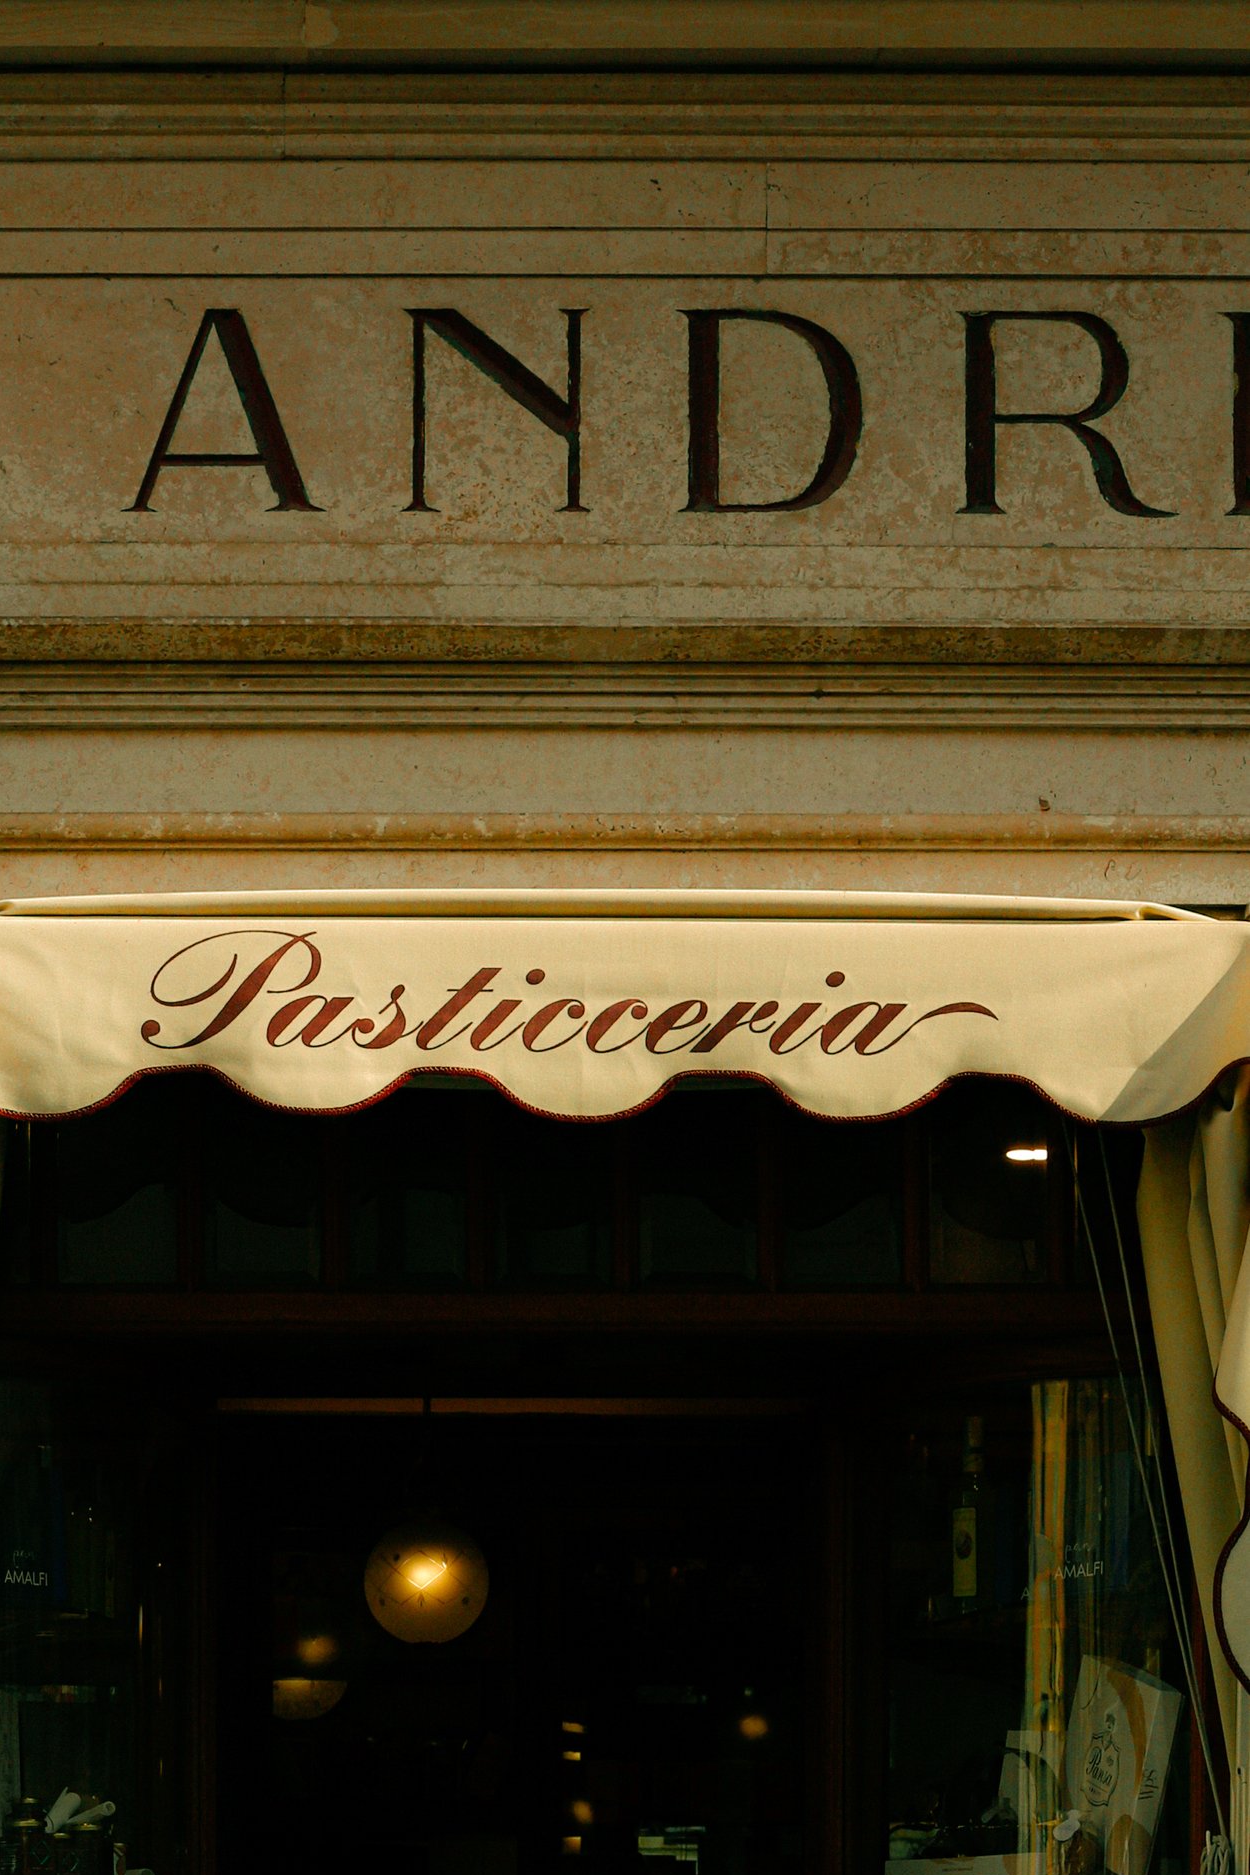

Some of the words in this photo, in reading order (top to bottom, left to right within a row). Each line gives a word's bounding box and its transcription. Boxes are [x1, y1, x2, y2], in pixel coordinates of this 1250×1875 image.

[120, 307, 1250, 518] ANDR
[139, 930, 998, 1056] Pasticceria
[4, 1569, 48, 1587] AMALFI
[1053, 1560, 1104, 1580] AMALFI
